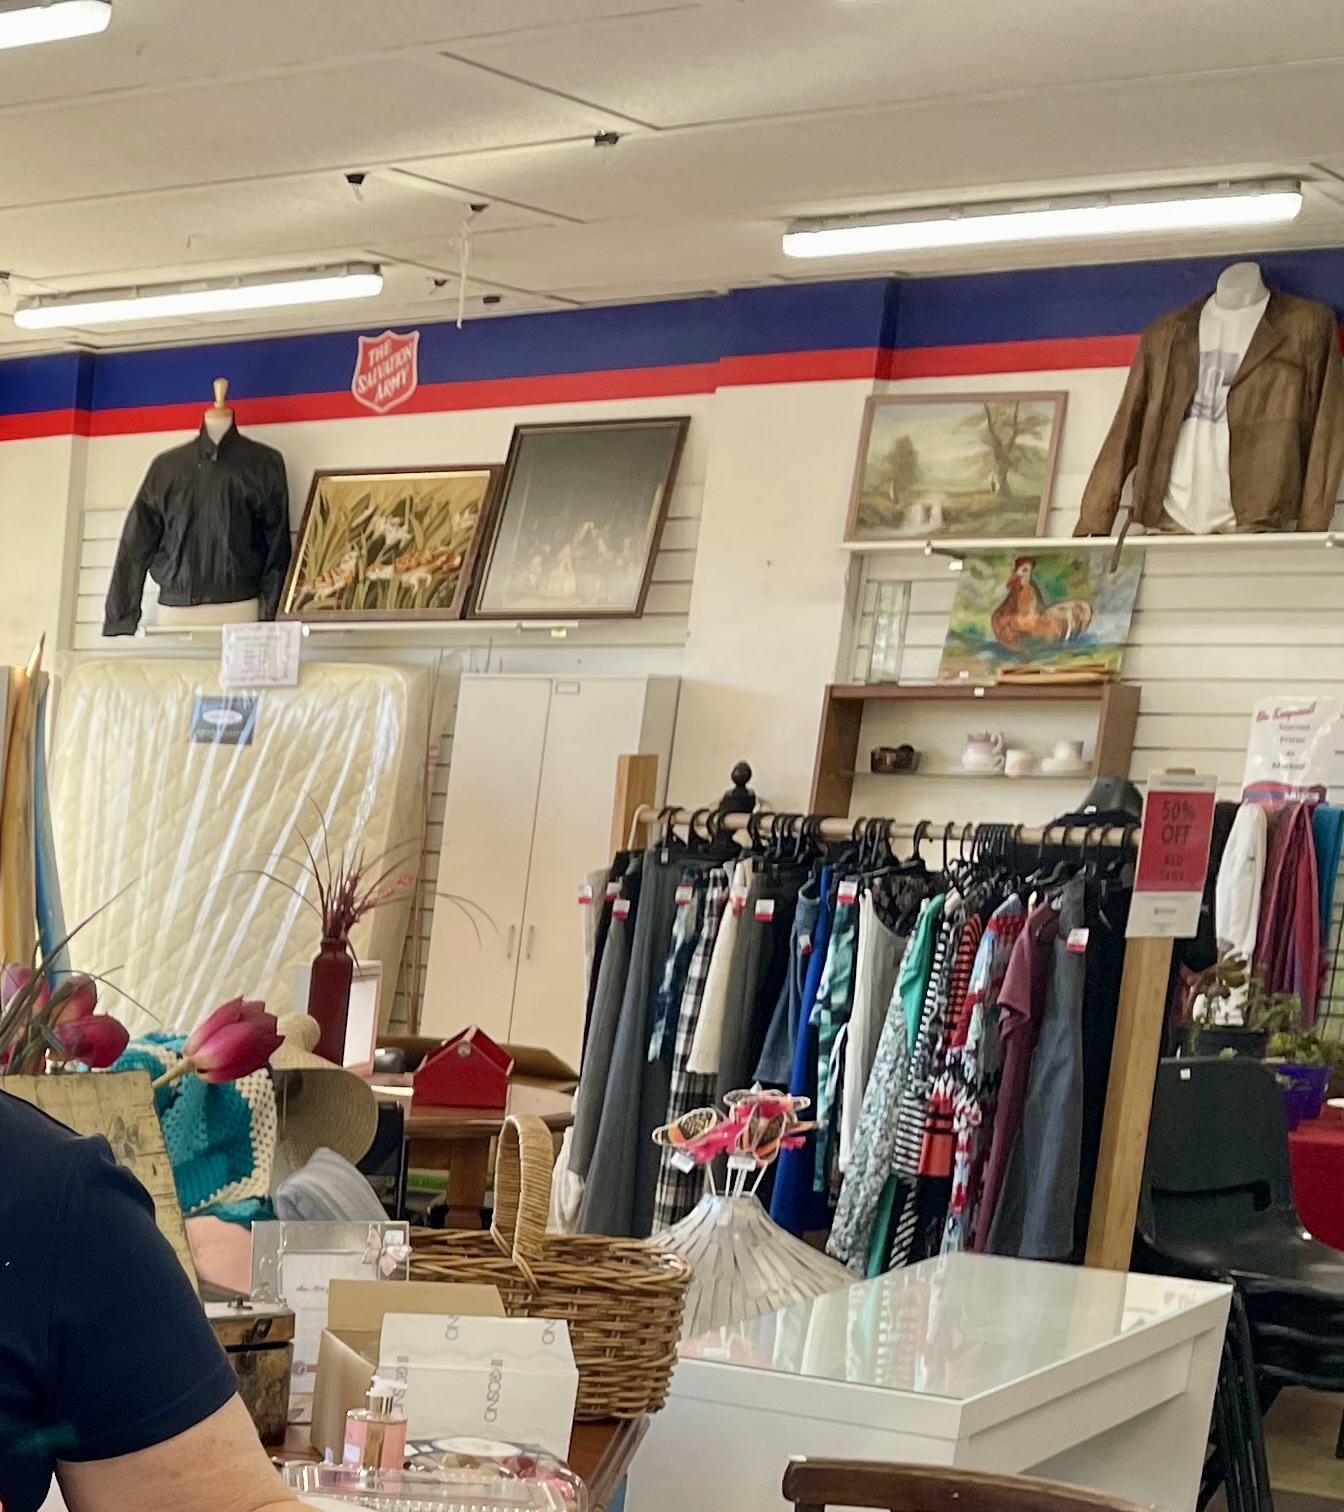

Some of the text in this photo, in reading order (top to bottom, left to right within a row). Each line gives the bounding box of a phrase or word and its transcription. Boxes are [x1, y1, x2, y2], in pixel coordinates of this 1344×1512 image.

[357, 341, 413, 395] SALVATION
[368, 339, 392, 368] THE
[374, 362, 409, 404] ARMY
[1162, 800, 1196, 822] 50%
[1162, 825, 1192, 845] OFF
